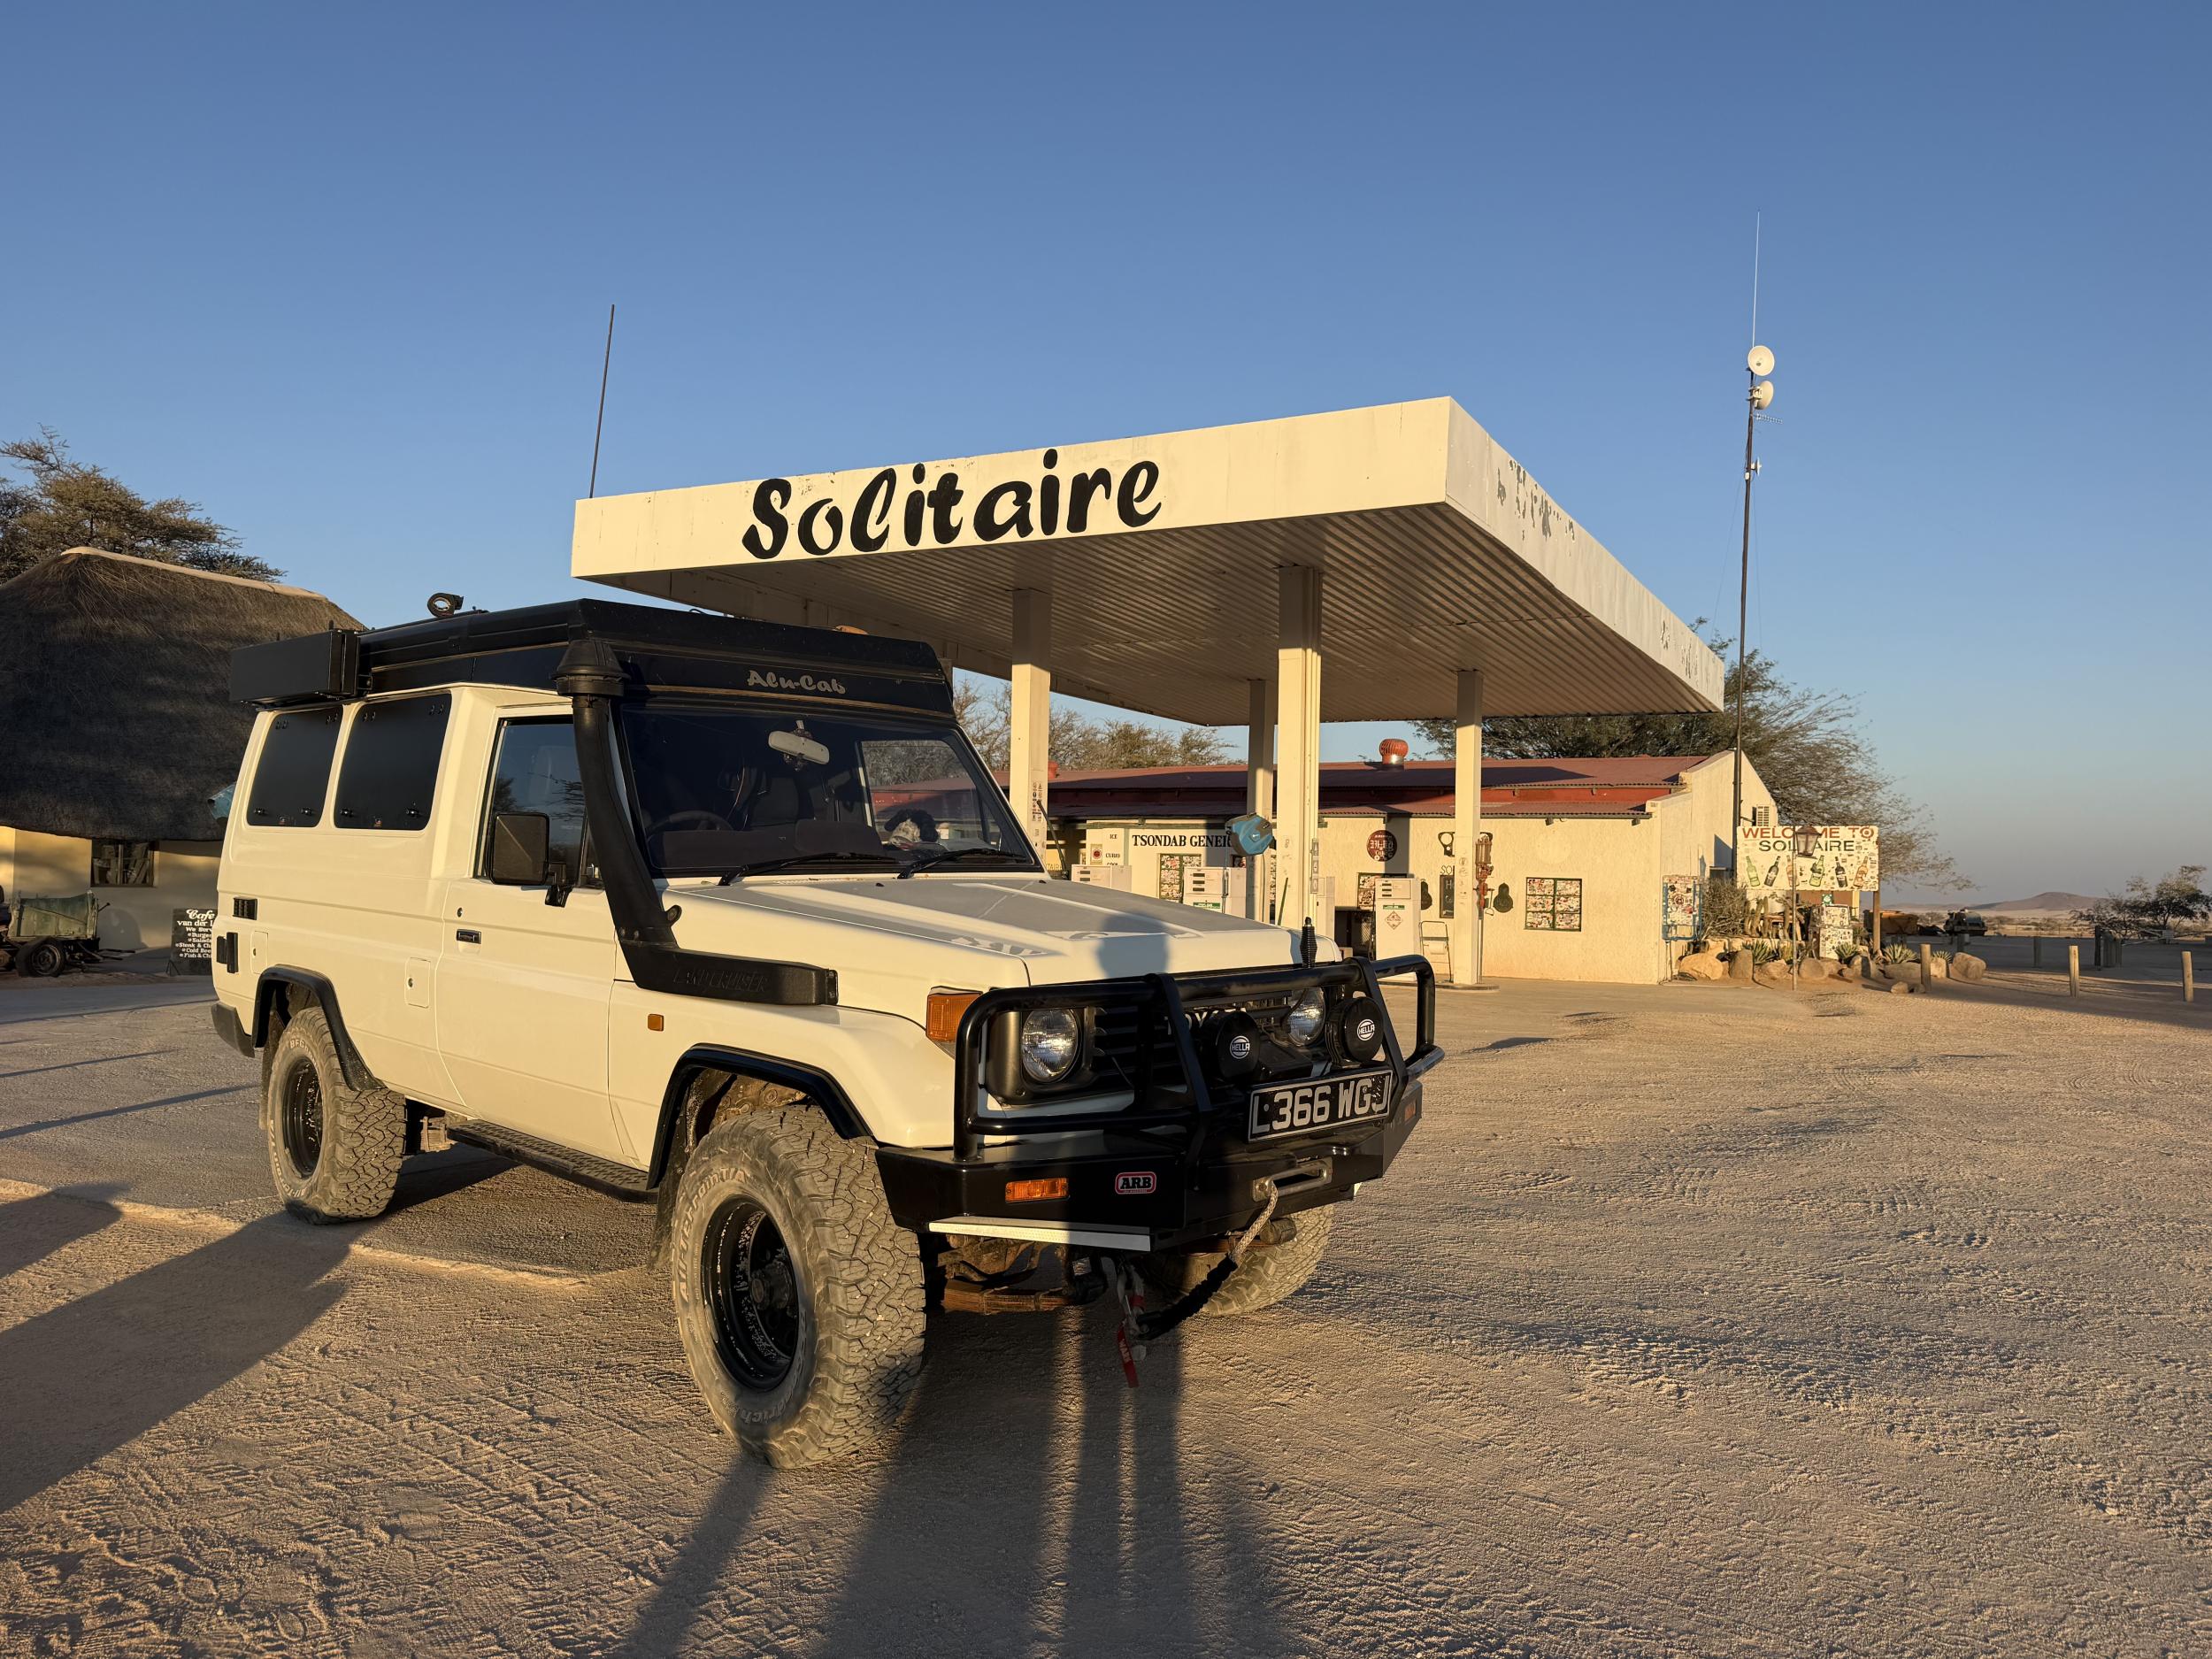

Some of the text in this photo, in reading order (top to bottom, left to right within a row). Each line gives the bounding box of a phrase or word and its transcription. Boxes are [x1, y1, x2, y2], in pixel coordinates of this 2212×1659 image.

[741, 449, 1162, 559] Solitaire
[747, 670, 846, 695] Alu-Cab
[1742, 826, 1875, 839] WELCME TO
[1132, 834, 1187, 847] TSONDAB
[1758, 840, 1855, 852] SOLAIRE
[186, 909, 215, 921] Cafe
[1357, 1024, 1376, 1035] HELLA
[1230, 1041, 1251, 1053] HELLA
[1252, 1074, 1390, 1135] L366 WGJ
[1119, 1176, 1152, 1190] ARB
